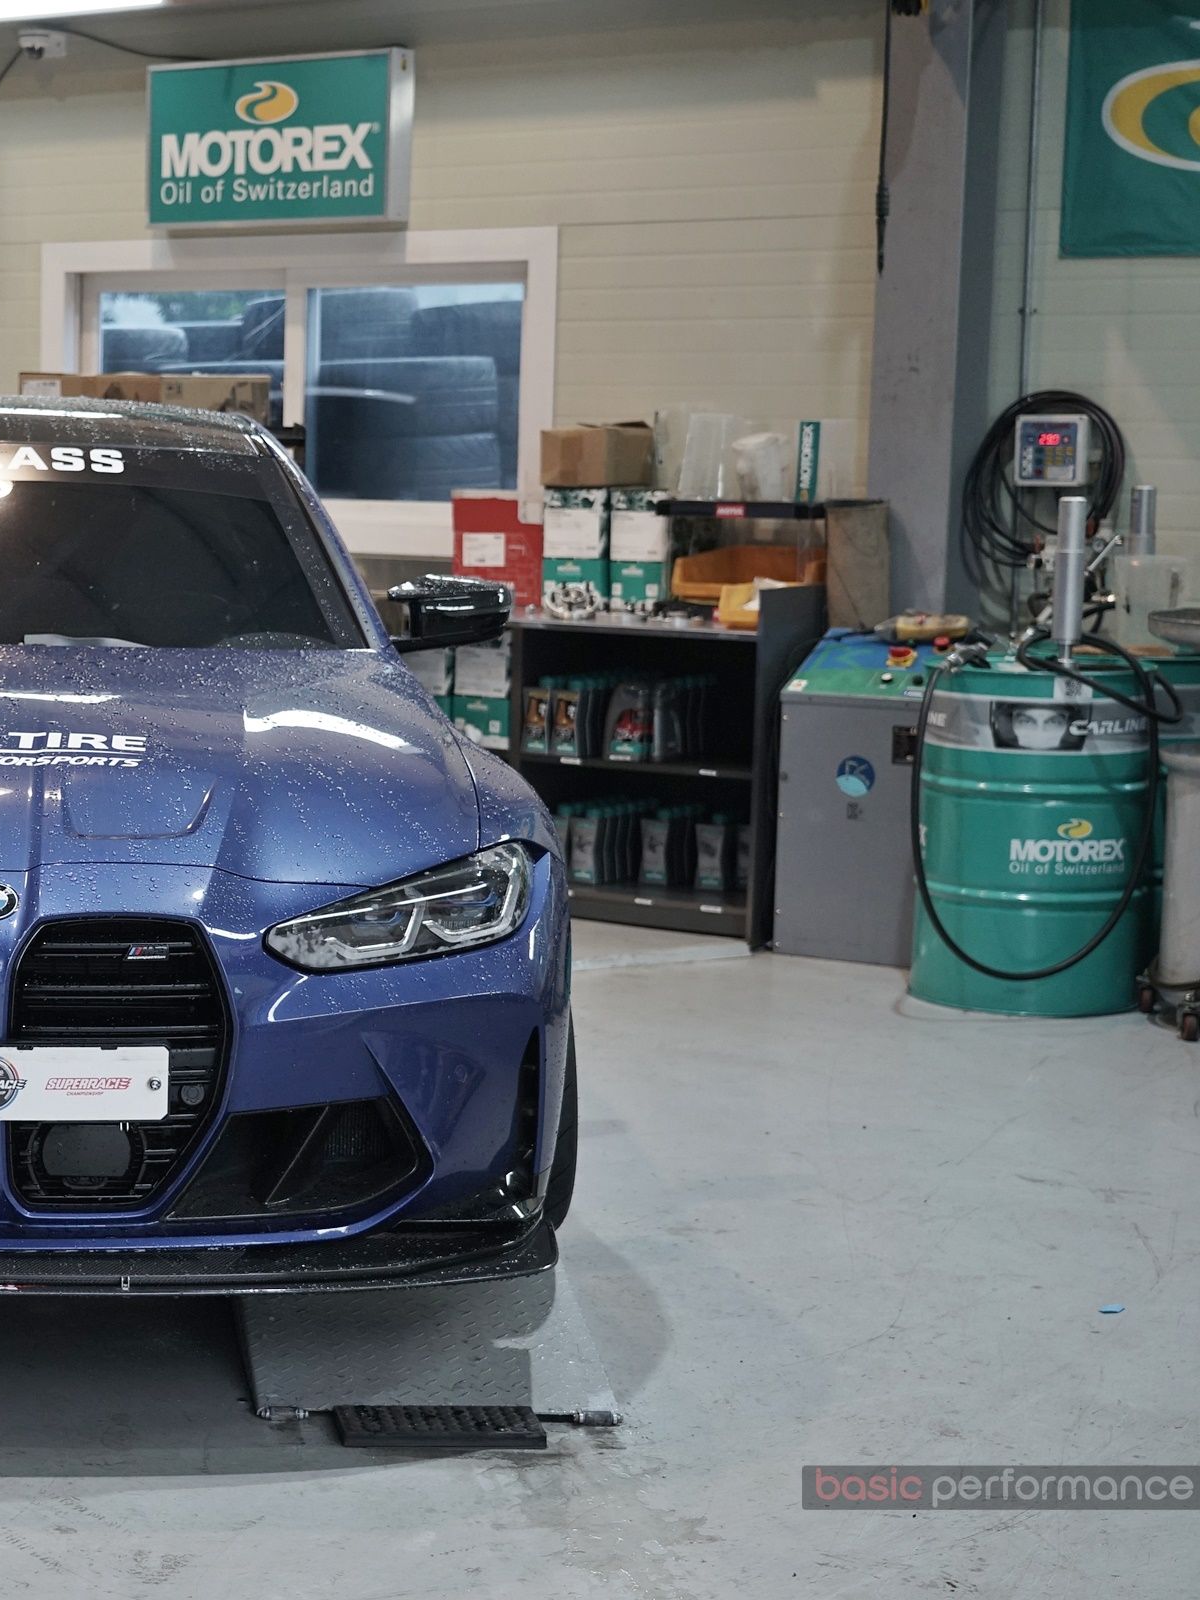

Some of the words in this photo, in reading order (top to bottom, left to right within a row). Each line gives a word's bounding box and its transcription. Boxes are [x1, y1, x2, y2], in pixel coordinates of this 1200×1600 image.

[161, 123, 373, 179] MOTOREX
[161, 182, 192, 205] Oil
[201, 180, 224, 203] of
[233, 173, 375, 201] Switzerland
[8, 731, 147, 751] TIRE
[1010, 838, 1125, 862] MOTOREX
[1009, 862, 1029, 874] Oil
[1035, 863, 1050, 875] of
[1055, 862, 1124, 876] Switzerland
[45, 1077, 133, 1090] SUPERRACE
